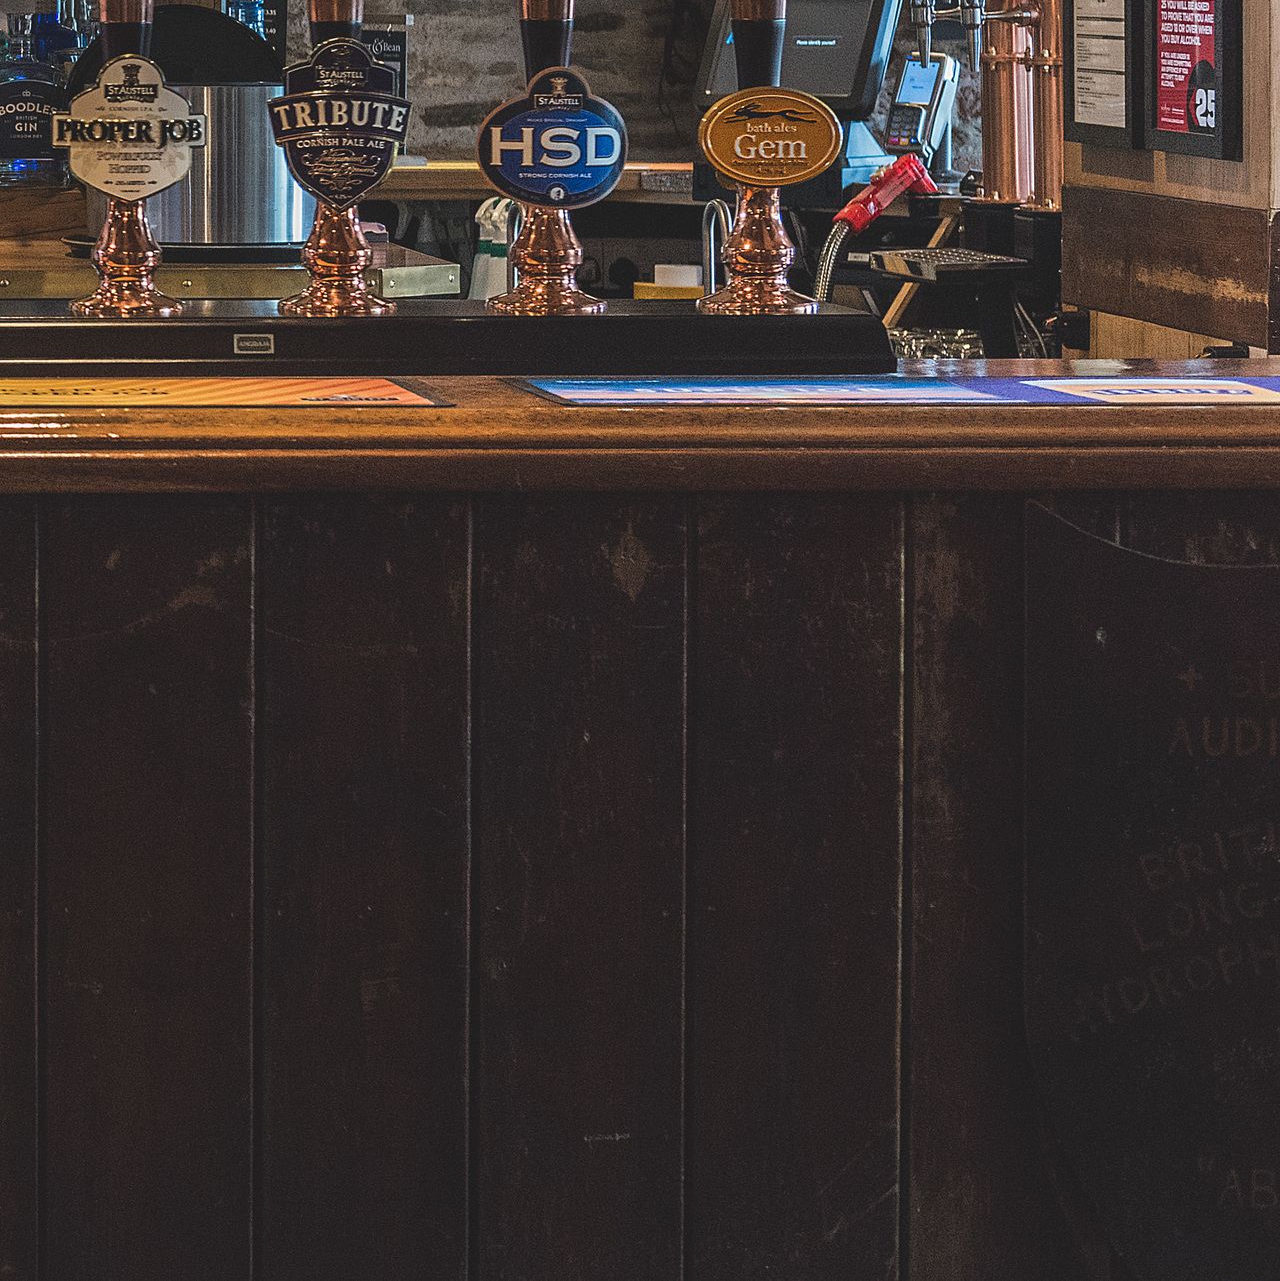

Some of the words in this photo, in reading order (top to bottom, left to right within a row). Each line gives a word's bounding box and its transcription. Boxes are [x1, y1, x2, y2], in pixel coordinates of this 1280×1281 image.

[1167, 0, 1176, 9] YOU
[1161, 11, 1167, 20] TO
[1167, 12, 1183, 21] PROVE
[1161, 34, 1170, 44] YOU
[1171, 35, 1180, 44] BUY
[383, 42, 401, 52] Bean
[329, 69, 364, 79] AUSTELL
[119, 85, 154, 96] AUSTELL
[549, 96, 579, 106] AUSTELL
[1196, 89, 1215, 128] 25
[274, 100, 407, 133] TRIBUTE
[15, 122, 38, 132] GIN
[747, 122, 772, 133] bath
[774, 122, 797, 133] ales
[56, 119, 155, 145] PROPER
[159, 118, 202, 148] JOB
[296, 138, 339, 148] CORNISH
[341, 137, 365, 147] PALE
[367, 139, 386, 149] ALE
[490, 126, 622, 167] HSD
[735, 135, 806, 159] Gem
[97, 150, 163, 161] POWERFULLY
